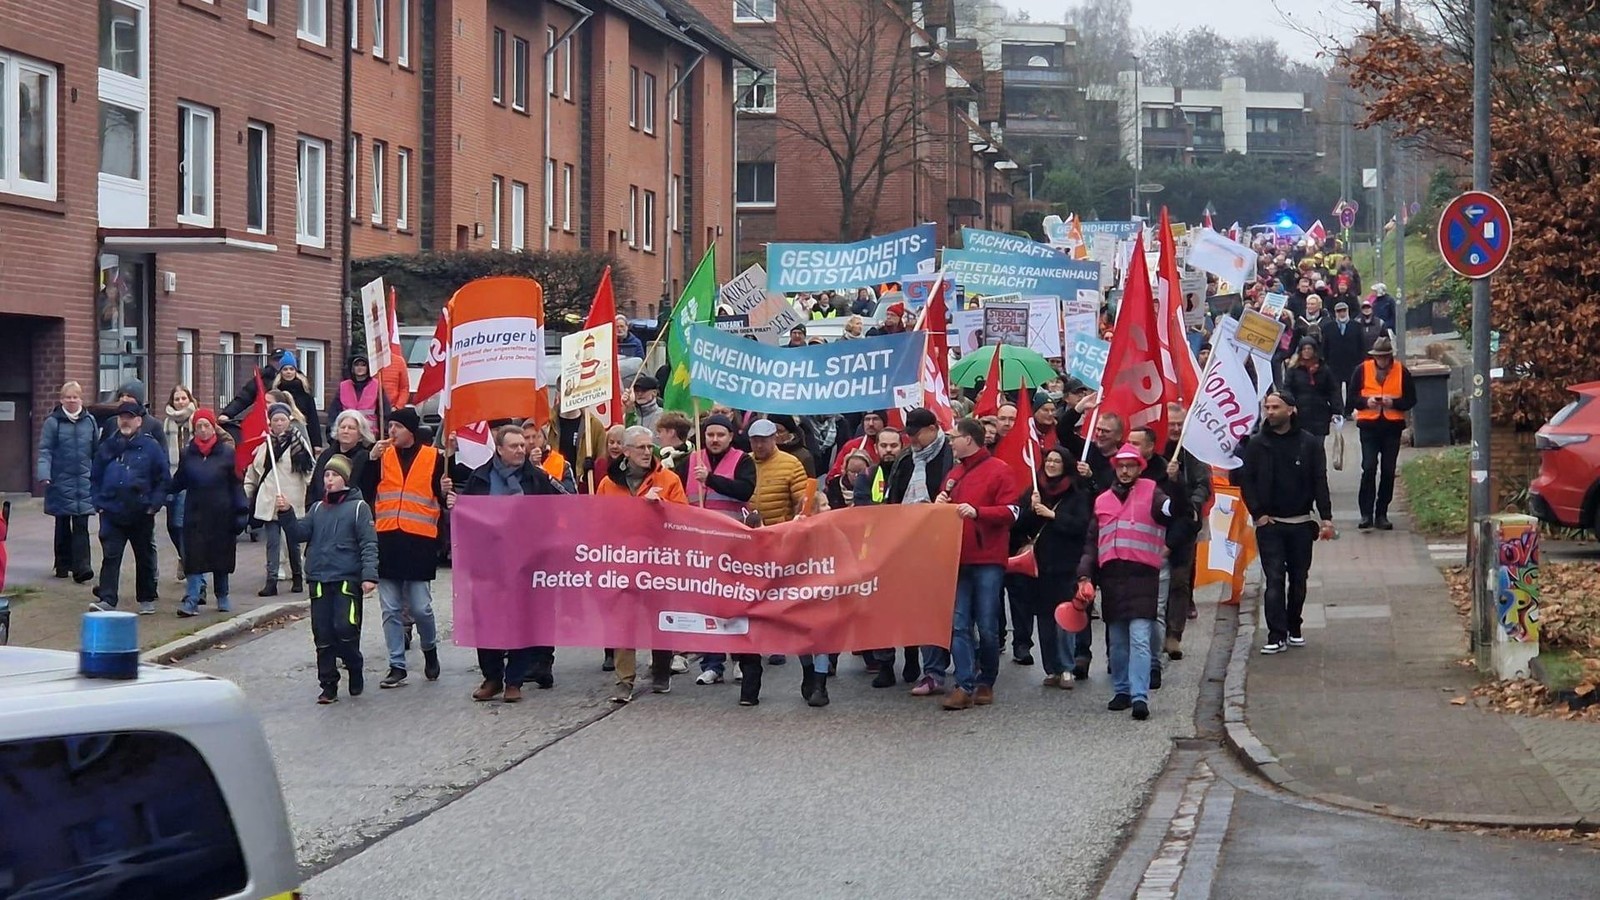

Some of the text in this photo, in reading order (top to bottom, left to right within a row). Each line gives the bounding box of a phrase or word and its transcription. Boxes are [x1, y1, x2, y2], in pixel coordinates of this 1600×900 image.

[1057, 223, 1119, 233] GENDHEIT
[780, 234, 928, 268] GESUNDHEITS-
[969, 232, 1055, 258] FACHKRÄFTE
[779, 259, 898, 286] NOTSTAND!
[948, 260, 1098, 281] RETTET DAS KRANKENHAUS
[956, 271, 1038, 289] EESTHACHT!
[454, 331, 526, 351] marburger
[693, 338, 894, 378] GEMEINWOHL STATT
[691, 361, 887, 400] INVESTORENWOHL!
[1192, 401, 1233, 458] kscha
[574, 544, 835, 579] Solidarität für Geesthacht!
[532, 570, 879, 602] Rettet die Gesundheitsversorgung!
